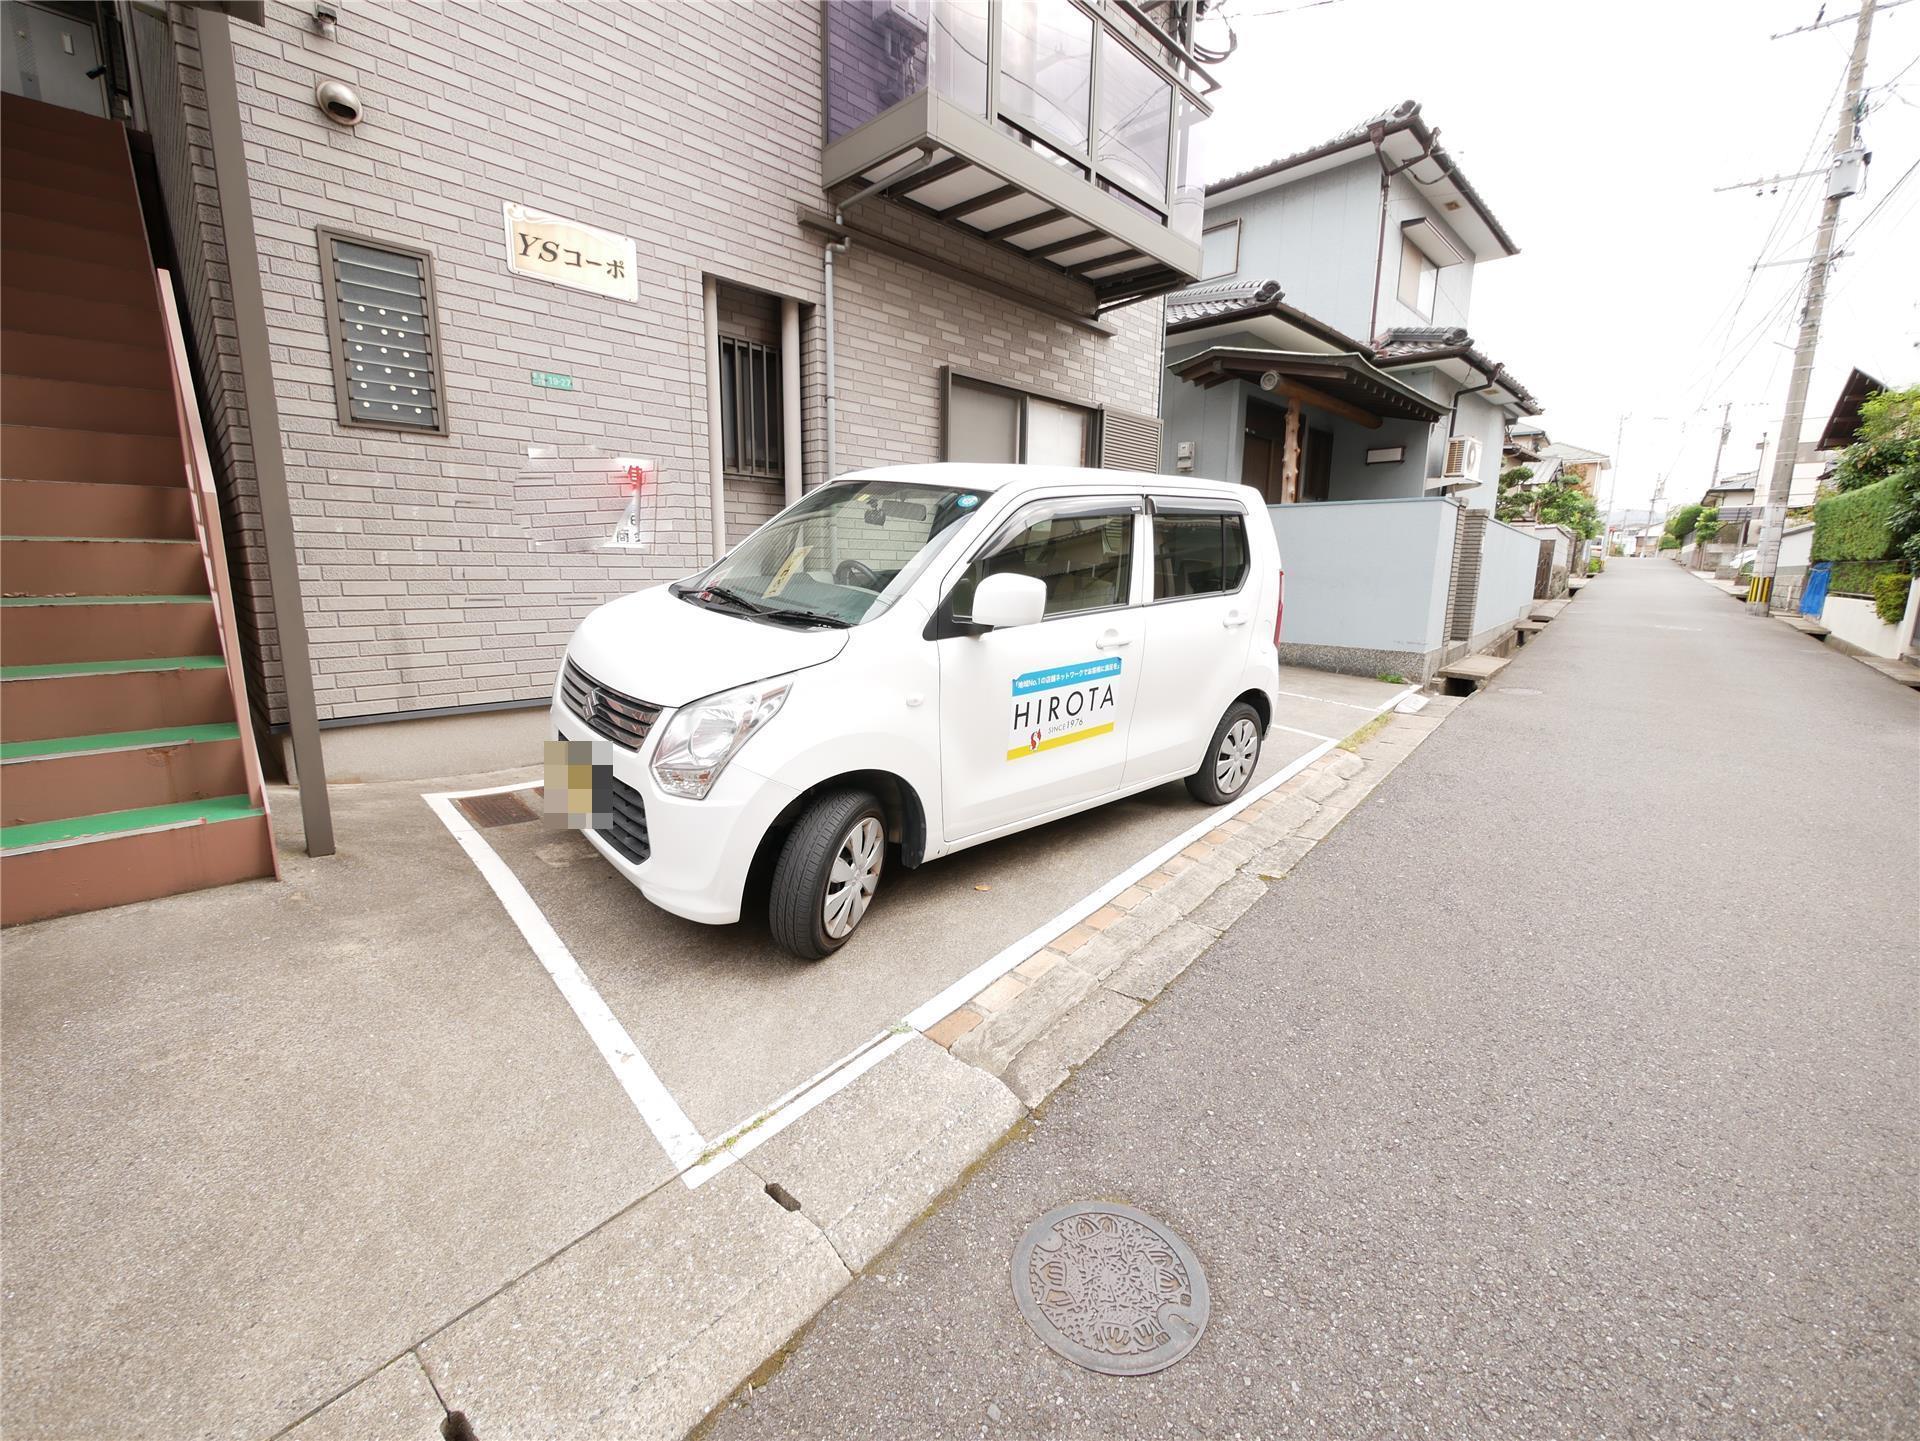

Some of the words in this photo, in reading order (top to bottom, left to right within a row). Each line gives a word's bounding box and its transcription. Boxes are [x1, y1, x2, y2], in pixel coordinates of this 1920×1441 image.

[518, 232, 625, 279] YSコーポ
[1013, 683, 1114, 730] HIROTA
